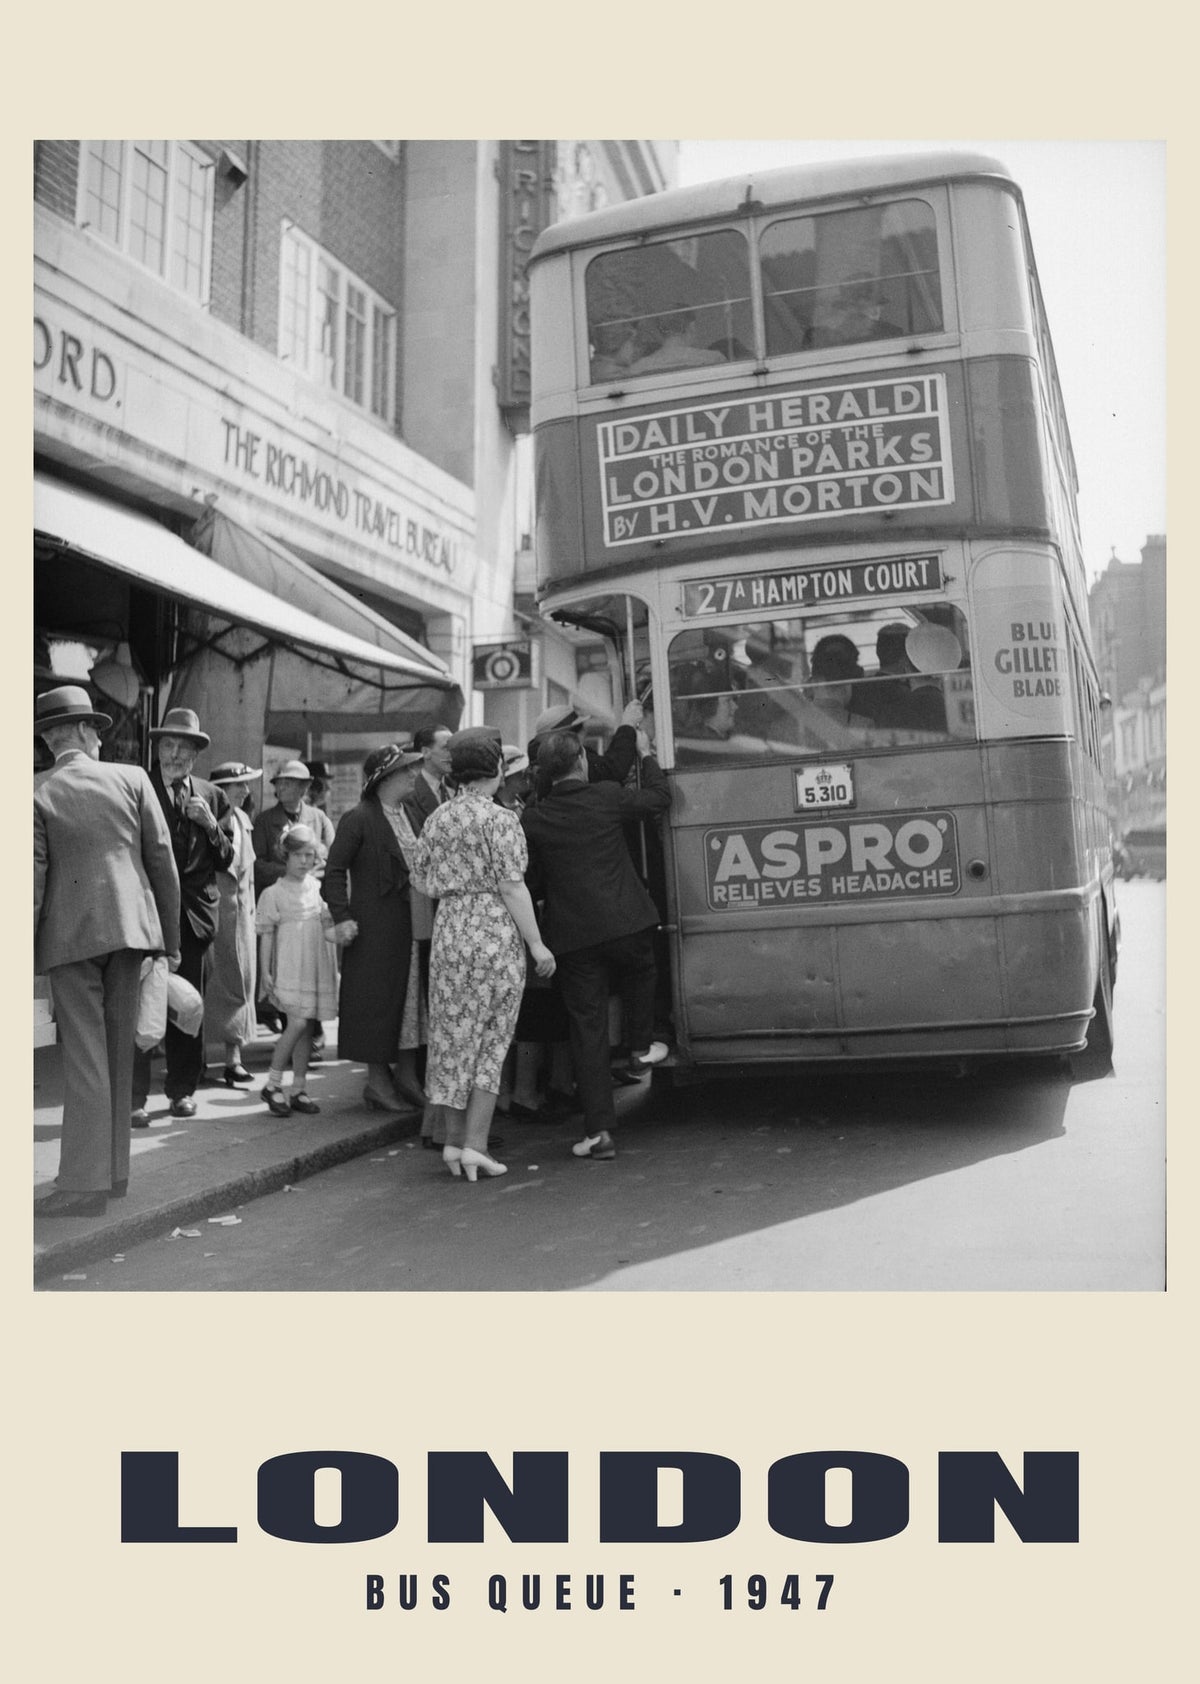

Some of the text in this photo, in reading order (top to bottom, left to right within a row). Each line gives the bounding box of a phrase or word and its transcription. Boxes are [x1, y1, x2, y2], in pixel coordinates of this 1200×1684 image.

[615, 384, 921, 454] DAILY HERALD
[609, 432, 933, 504] LONDON PARKS
[650, 424, 884, 468] THE ROMANCE OF THE
[220, 416, 457, 575] THE RICHMOND TRAVEL BUREAU
[743, 469, 940, 519] MORTON
[696, 559, 930, 615] 27A HAMPTON COURT
[994, 646, 1067, 675] GILLET
[1012, 677, 1066, 698] BLADE
[804, 784, 847, 803] 5.310
[713, 868, 954, 902] RELIEVES HEADACHE
